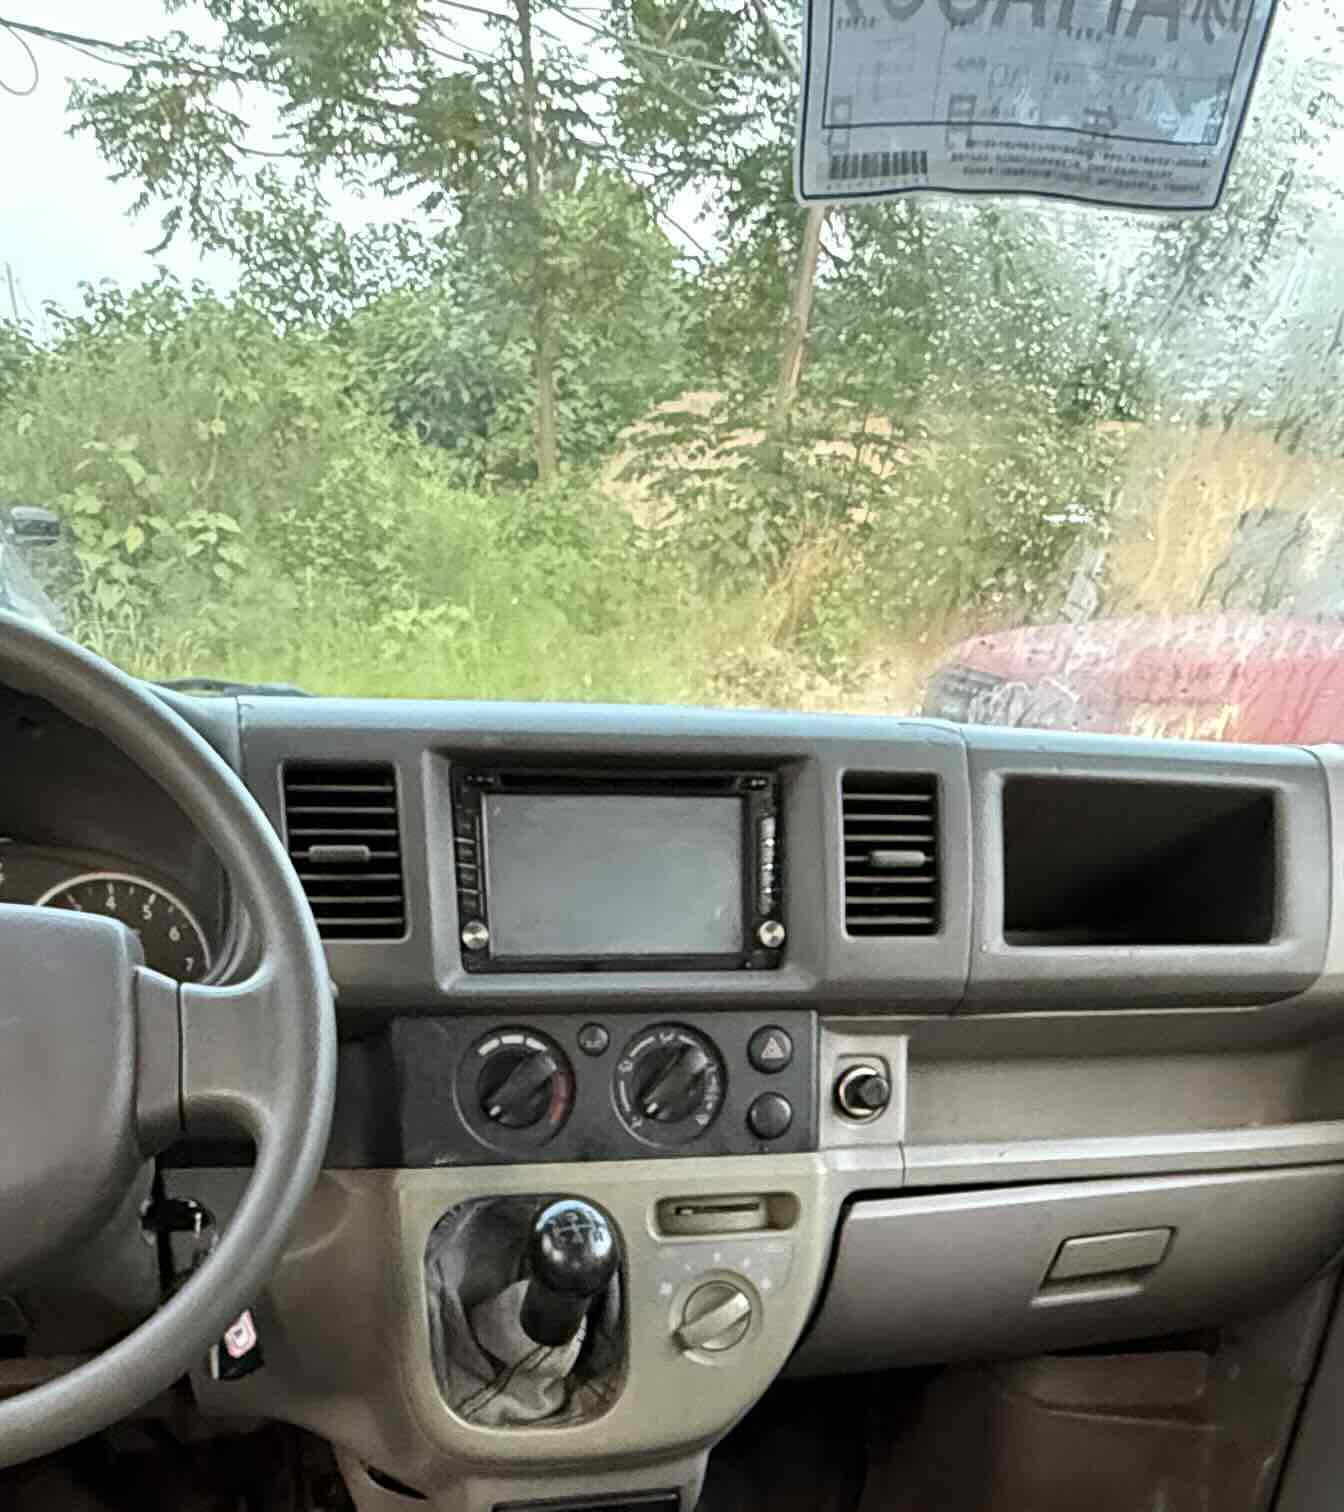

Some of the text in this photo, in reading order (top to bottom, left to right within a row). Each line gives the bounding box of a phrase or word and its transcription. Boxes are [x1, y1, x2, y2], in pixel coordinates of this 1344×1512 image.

[106, 894, 117, 911] 4
[142, 903, 153, 921] 5
[169, 925, 181, 942] 6
[184, 956, 195, 972] 7
